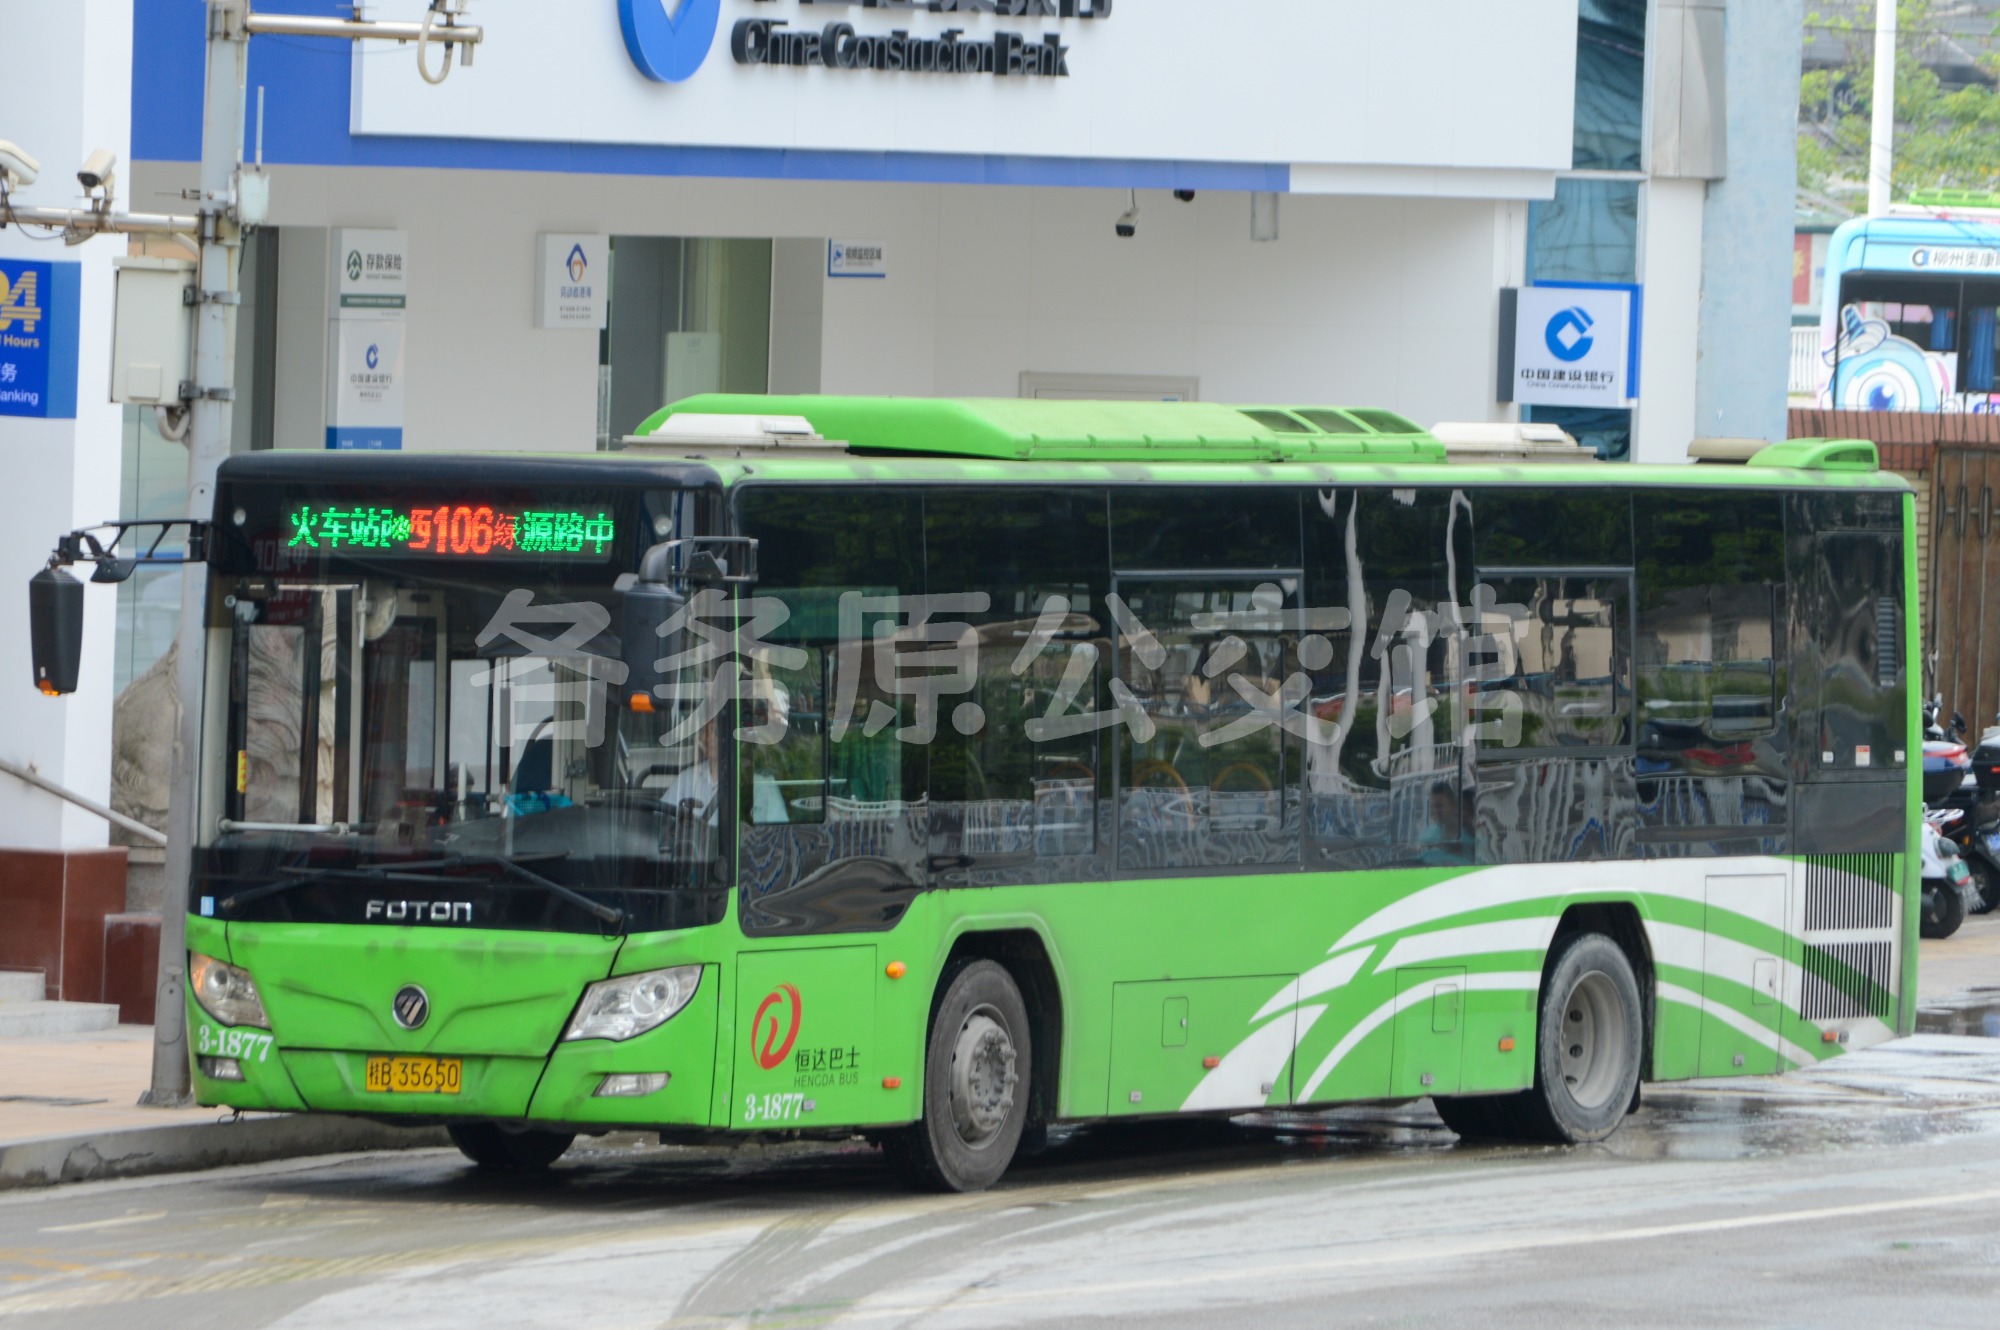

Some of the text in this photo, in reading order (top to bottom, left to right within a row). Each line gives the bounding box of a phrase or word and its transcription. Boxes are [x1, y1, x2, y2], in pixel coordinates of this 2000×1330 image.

[731, 18, 1070, 77] China Construction Bank
[366, 254, 402, 270] 存款保险
[4, 334, 40, 348] Hours
[1521, 368, 1614, 383] 中国建设银行
[1526, 380, 1607, 391] China Construction Bank
[366, 900, 472, 922] FOTON
[199, 1025, 273, 1063] 3-1877
[795, 1045, 860, 1073] 恒达巴士
[794, 1071, 859, 1088] HENGDA BUS
[744, 1093, 804, 1122] 3-1877
